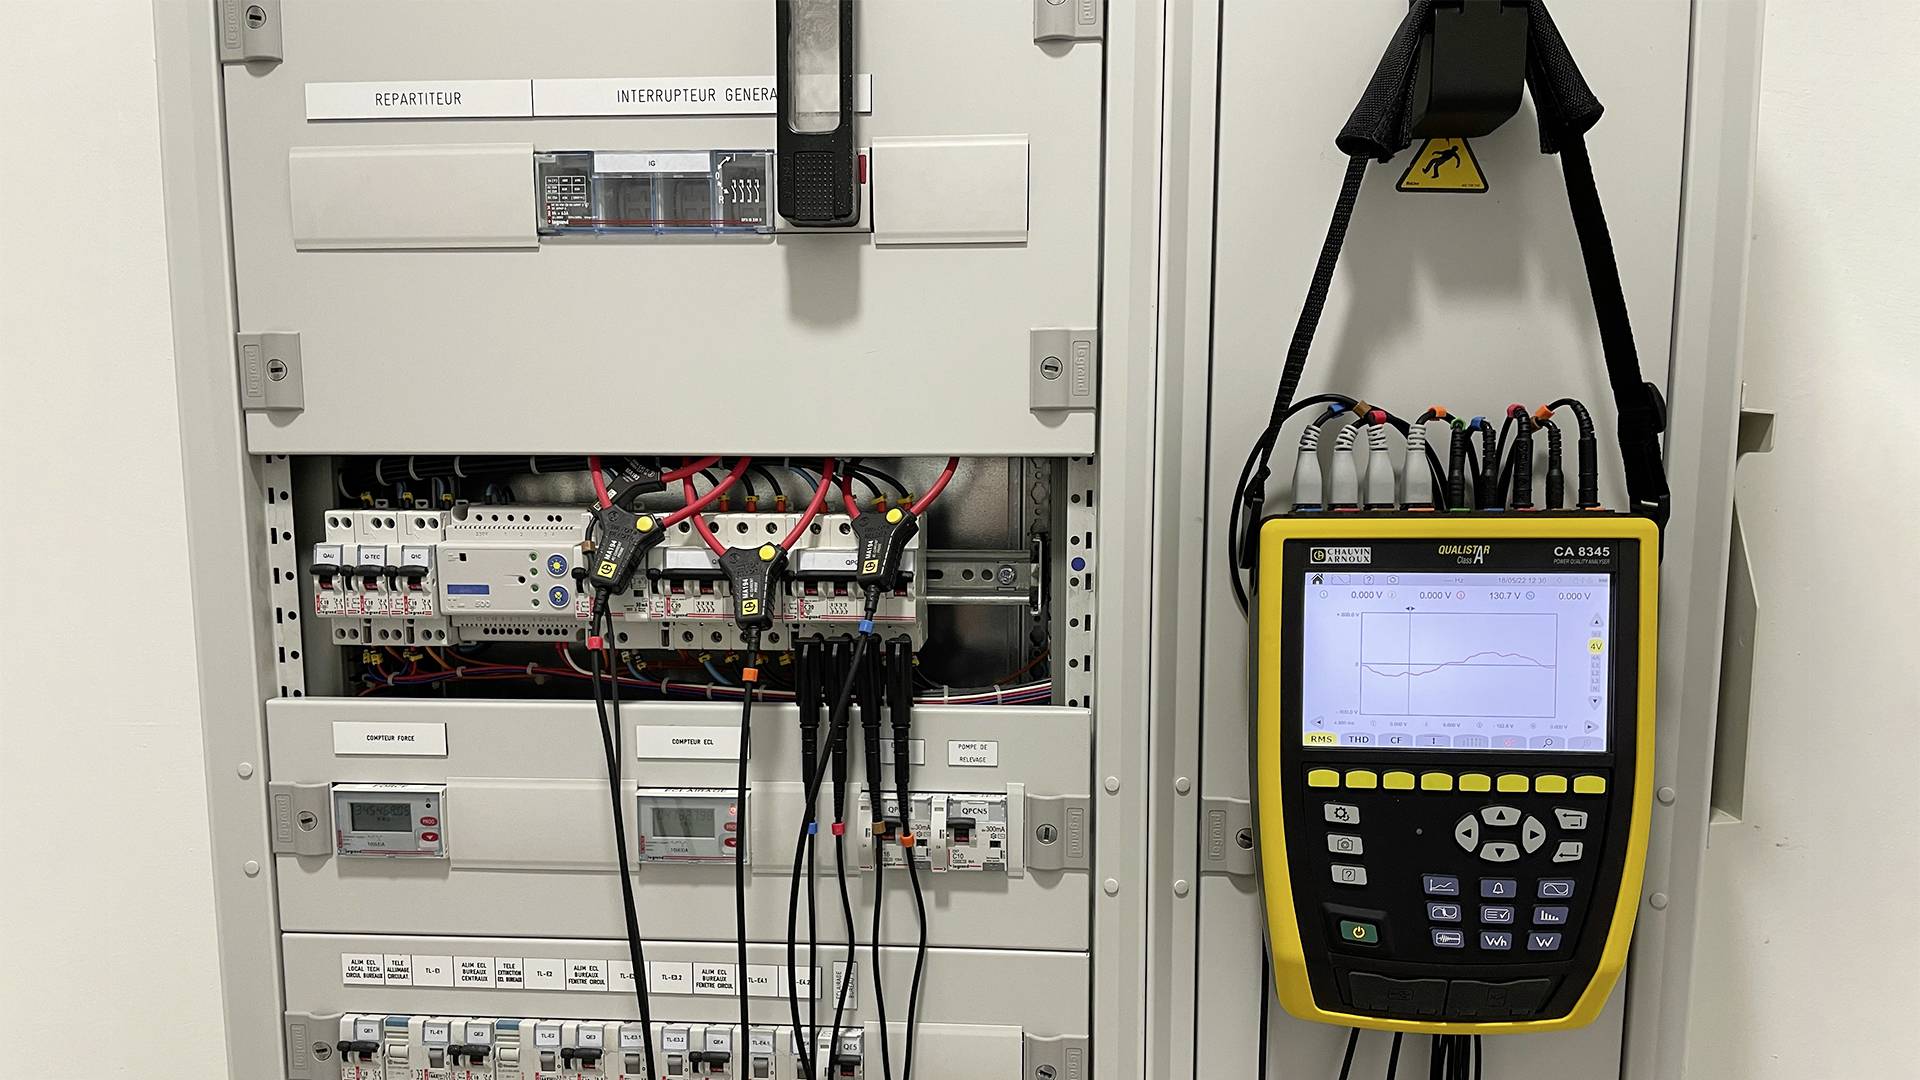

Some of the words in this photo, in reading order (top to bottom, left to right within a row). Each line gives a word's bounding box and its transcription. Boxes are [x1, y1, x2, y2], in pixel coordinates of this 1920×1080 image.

[374, 91, 462, 107] REPARTITEUR
[617, 88, 716, 103] INTERRUPTEUR
[725, 87, 778, 102] GENERA
[604, 540, 617, 561] MA194
[865, 540, 873, 559] MA194
[1438, 545, 1490, 555] QUALISTAR
[1554, 546, 1574, 557] CA
[1578, 546, 1610, 557] 8345
[1457, 555, 1472, 565] Class
[1351, 591, 1374, 599] 0.000
[1376, 591, 1383, 599] V
[1489, 592, 1511, 600] 130.7
[1514, 592, 1521, 600] V
[1558, 592, 1582, 600] 0.000
[1584, 592, 1591, 600] V
[1311, 735, 1332, 743] RMS
[1484, 936, 1507, 947] Wh
[1536, 936, 1553, 947] W
